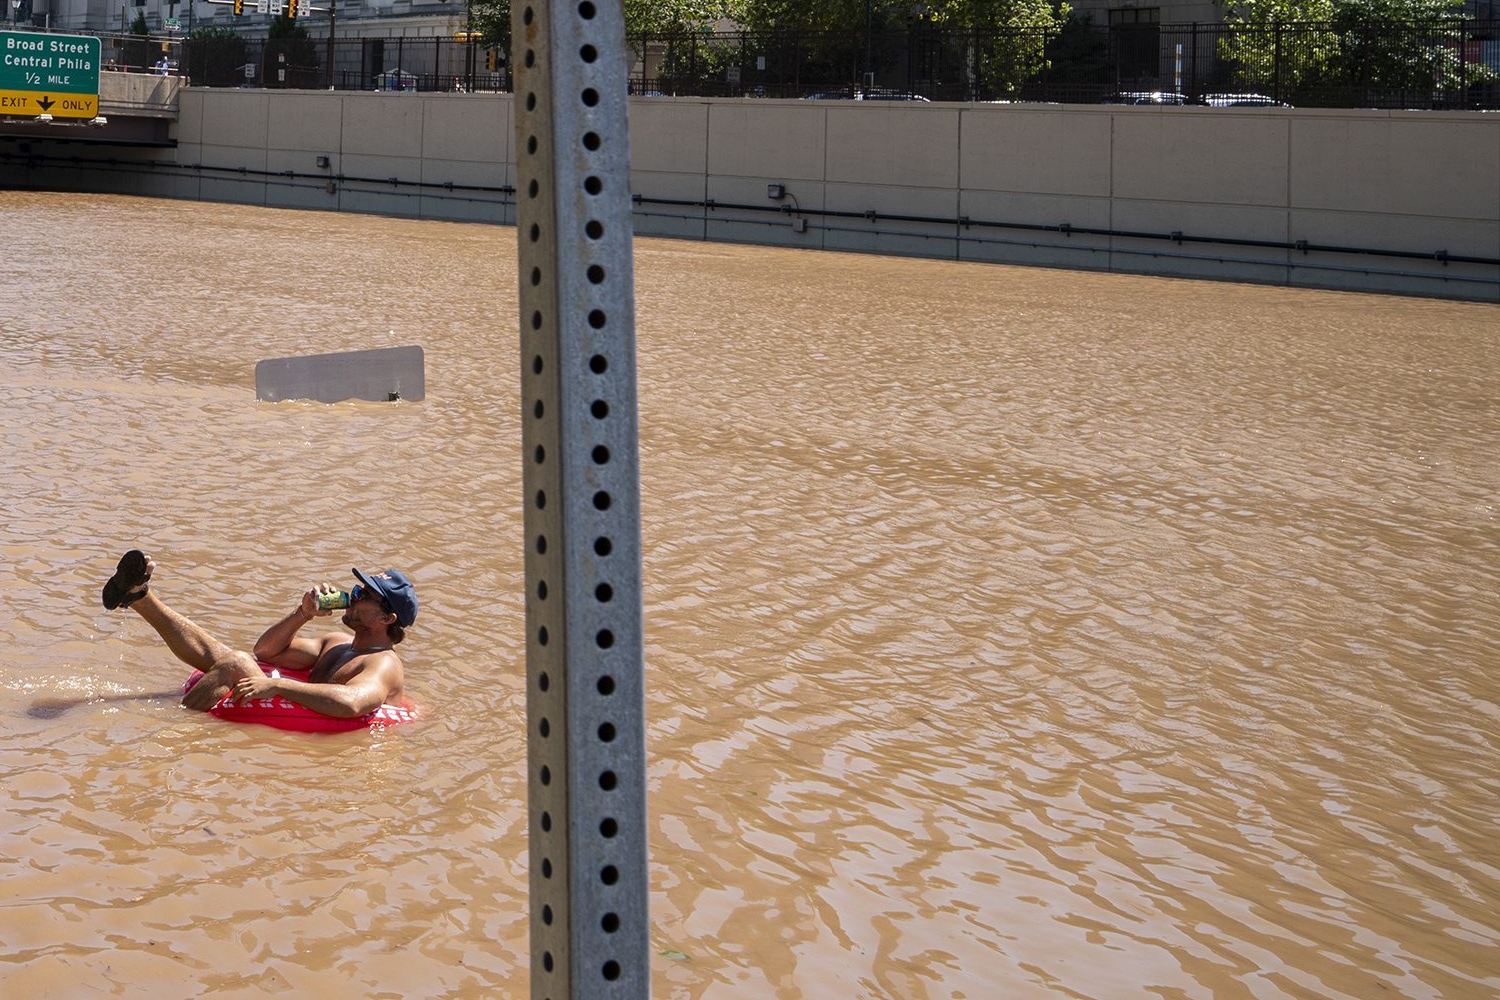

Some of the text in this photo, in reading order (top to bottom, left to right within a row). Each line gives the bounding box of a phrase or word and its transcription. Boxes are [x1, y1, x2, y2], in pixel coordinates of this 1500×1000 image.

[7, 38, 89, 54] Broad Street
[4, 54, 91, 70] Central Phila
[48, 75, 70, 85] MILE
[1, 97, 92, 111] EXIT ONLY
